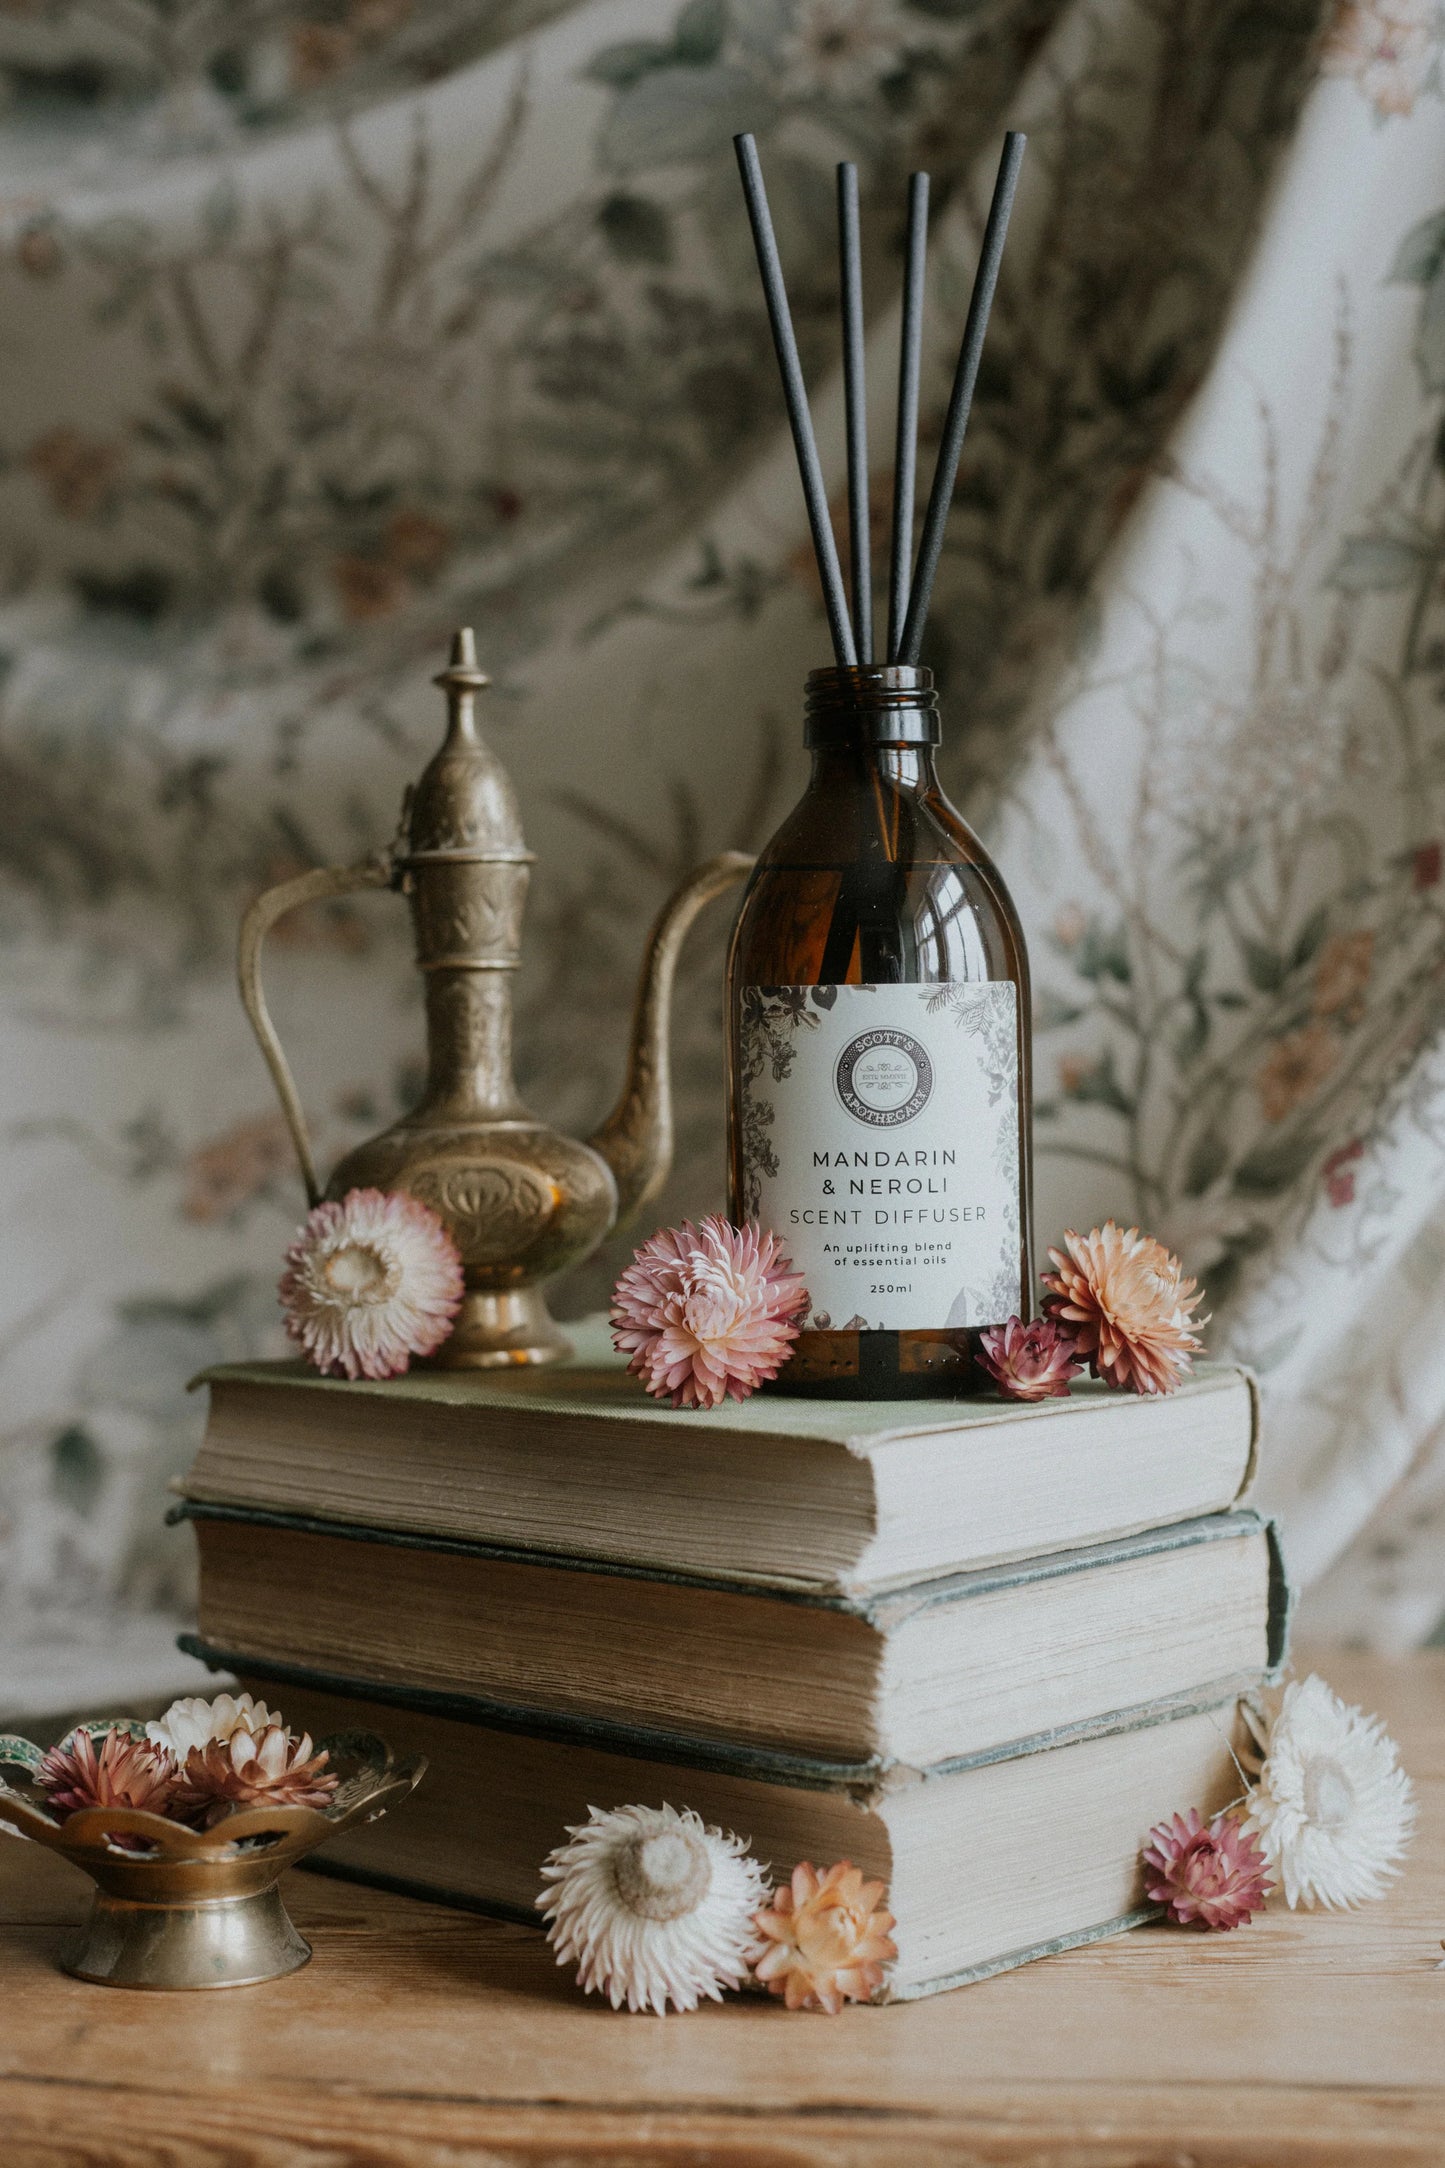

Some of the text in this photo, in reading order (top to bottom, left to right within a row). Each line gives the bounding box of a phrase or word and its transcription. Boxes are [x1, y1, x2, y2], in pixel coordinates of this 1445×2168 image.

[856, 1033, 914, 1052] SCOTT'S
[843, 1089, 926, 1123] APOTHECARY
[813, 1150, 956, 1167] MANDARIN
[822, 1177, 947, 1195] & NEROLI
[790, 1206, 986, 1224] SCENT DIFFUSER
[823, 1241, 952, 1254] An uplifting blend
[834, 1256, 947, 1266] of essential oils
[870, 1284, 912, 1294] 250ml
